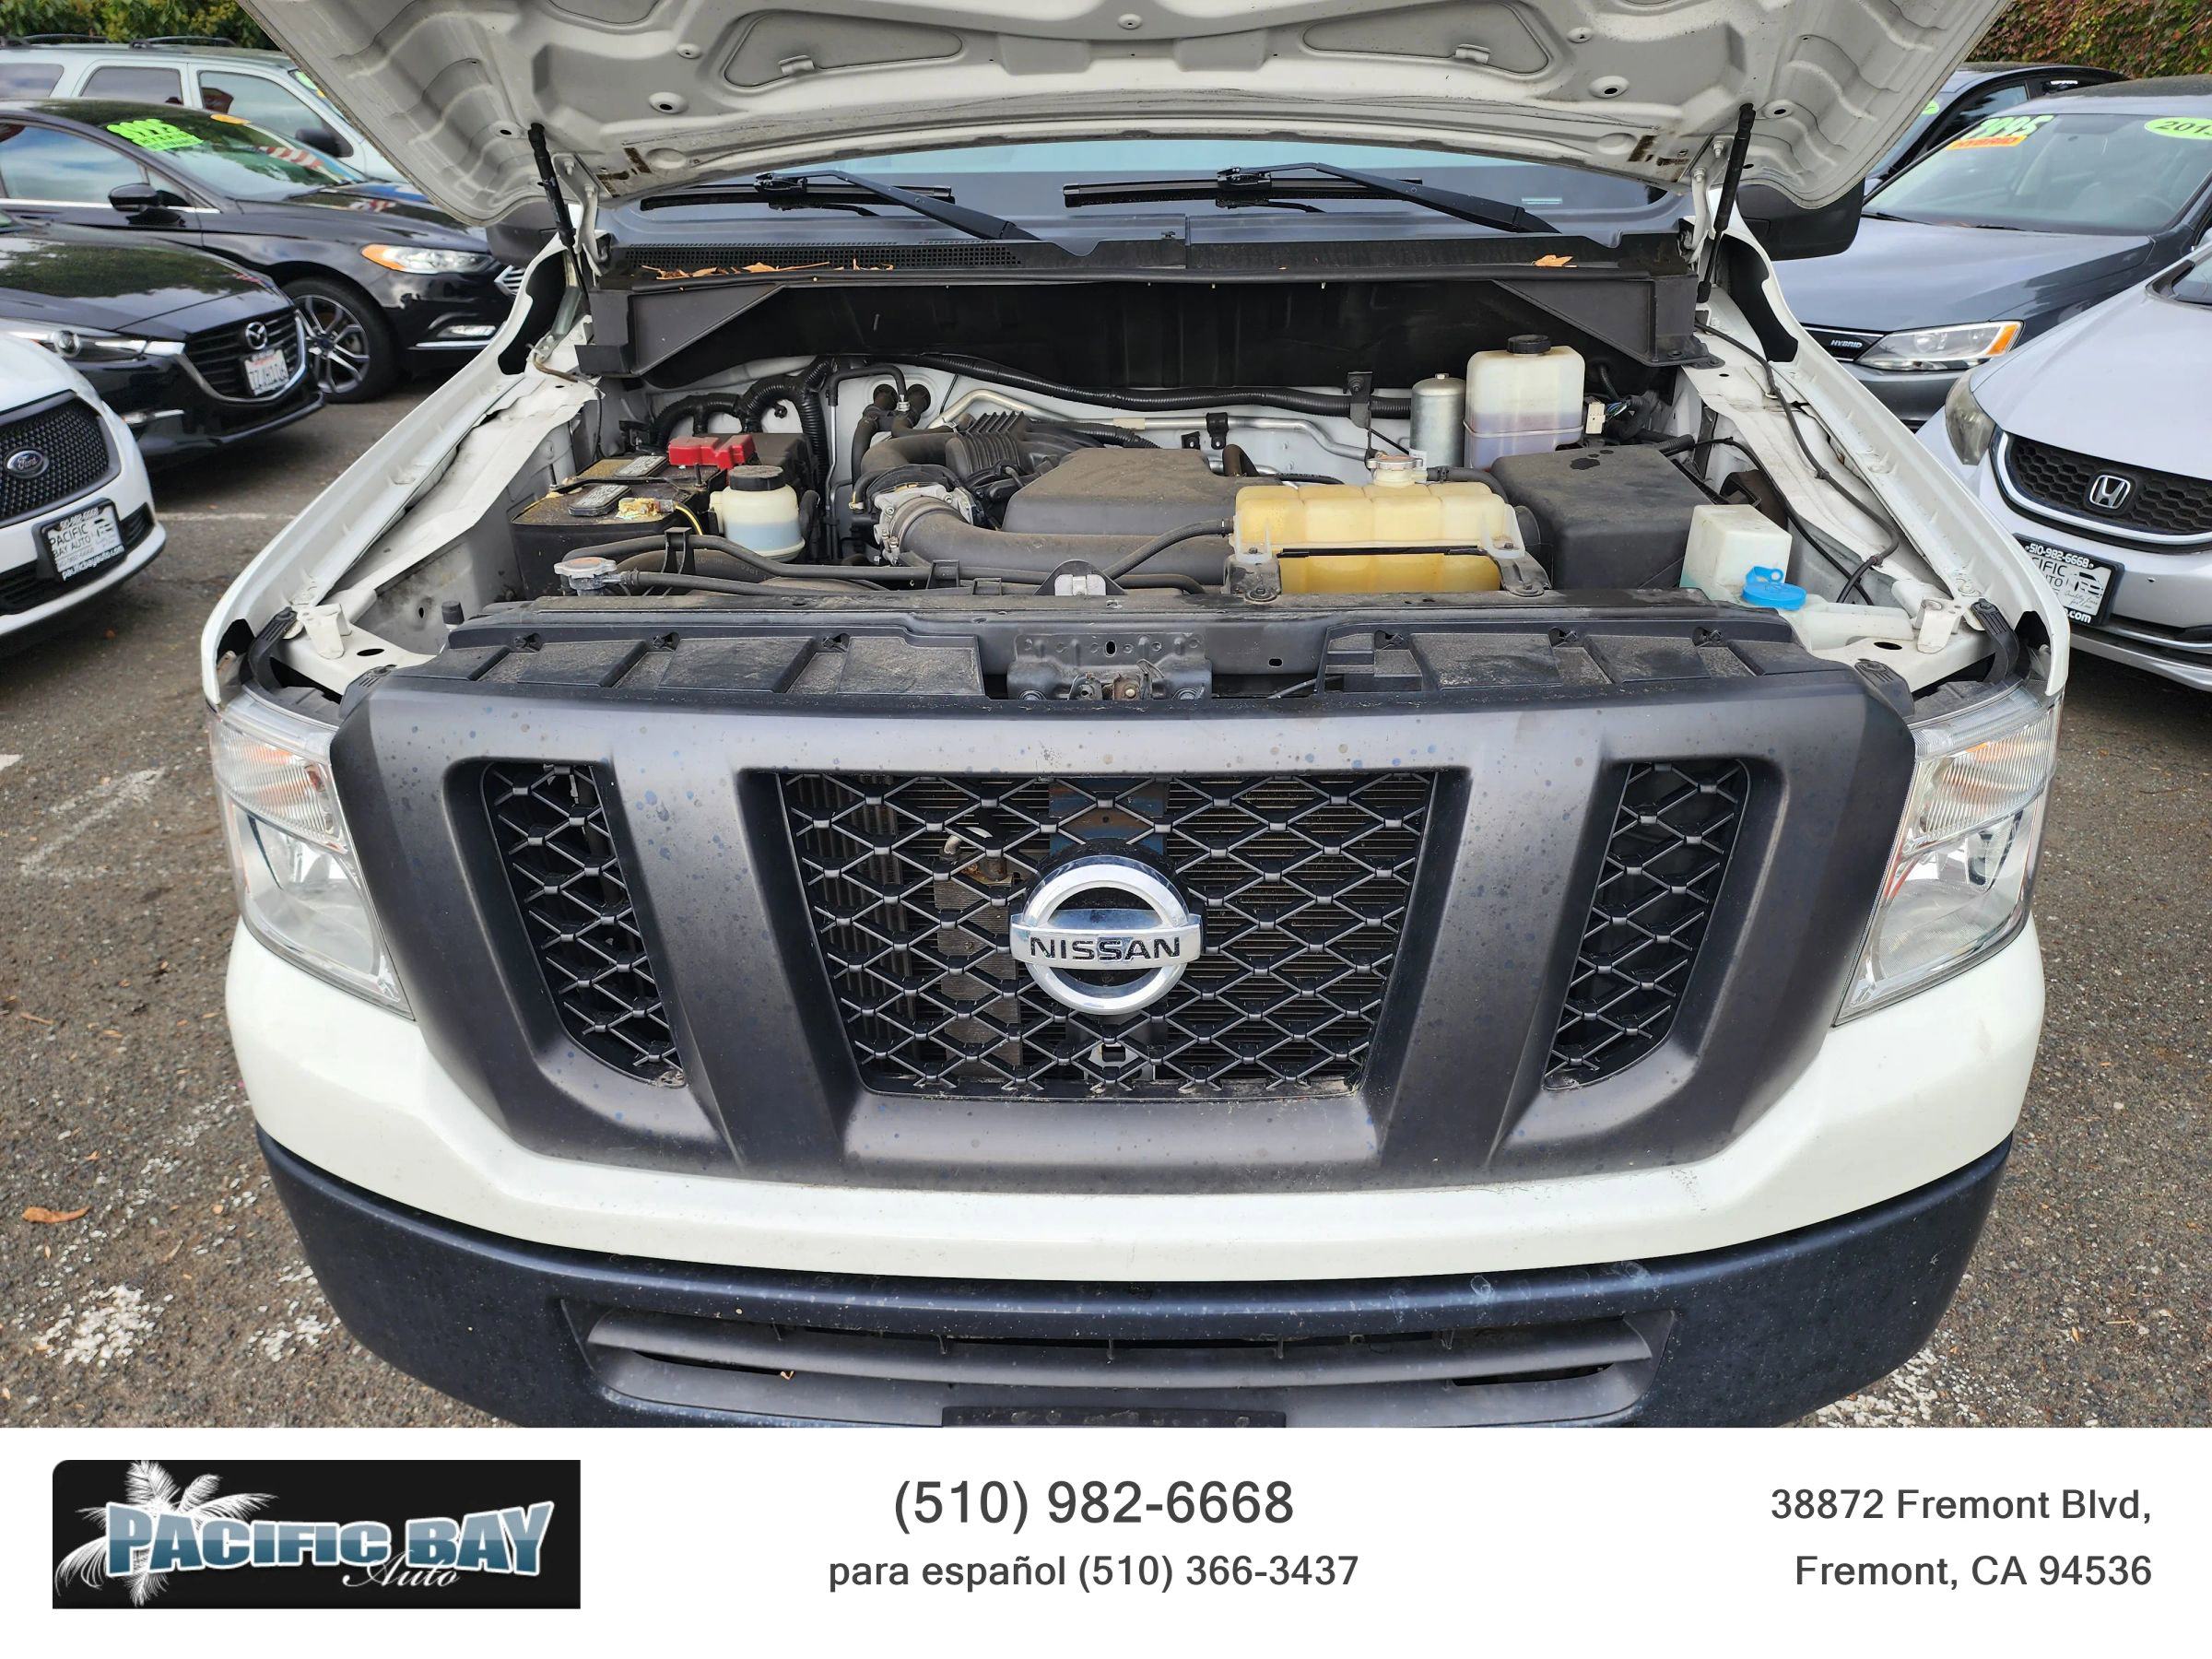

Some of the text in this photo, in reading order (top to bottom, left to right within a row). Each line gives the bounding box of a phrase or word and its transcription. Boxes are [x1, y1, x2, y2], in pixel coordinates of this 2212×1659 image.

[1830, 339, 1863, 348] HYBRID
[50, 524, 88, 547] PACIFIC
[71, 536, 91, 549] AUTO
[2029, 543, 2090, 569] 510-982-6668
[2031, 557, 2068, 578] IFIC
[1030, 936, 1181, 960] NISSAN
